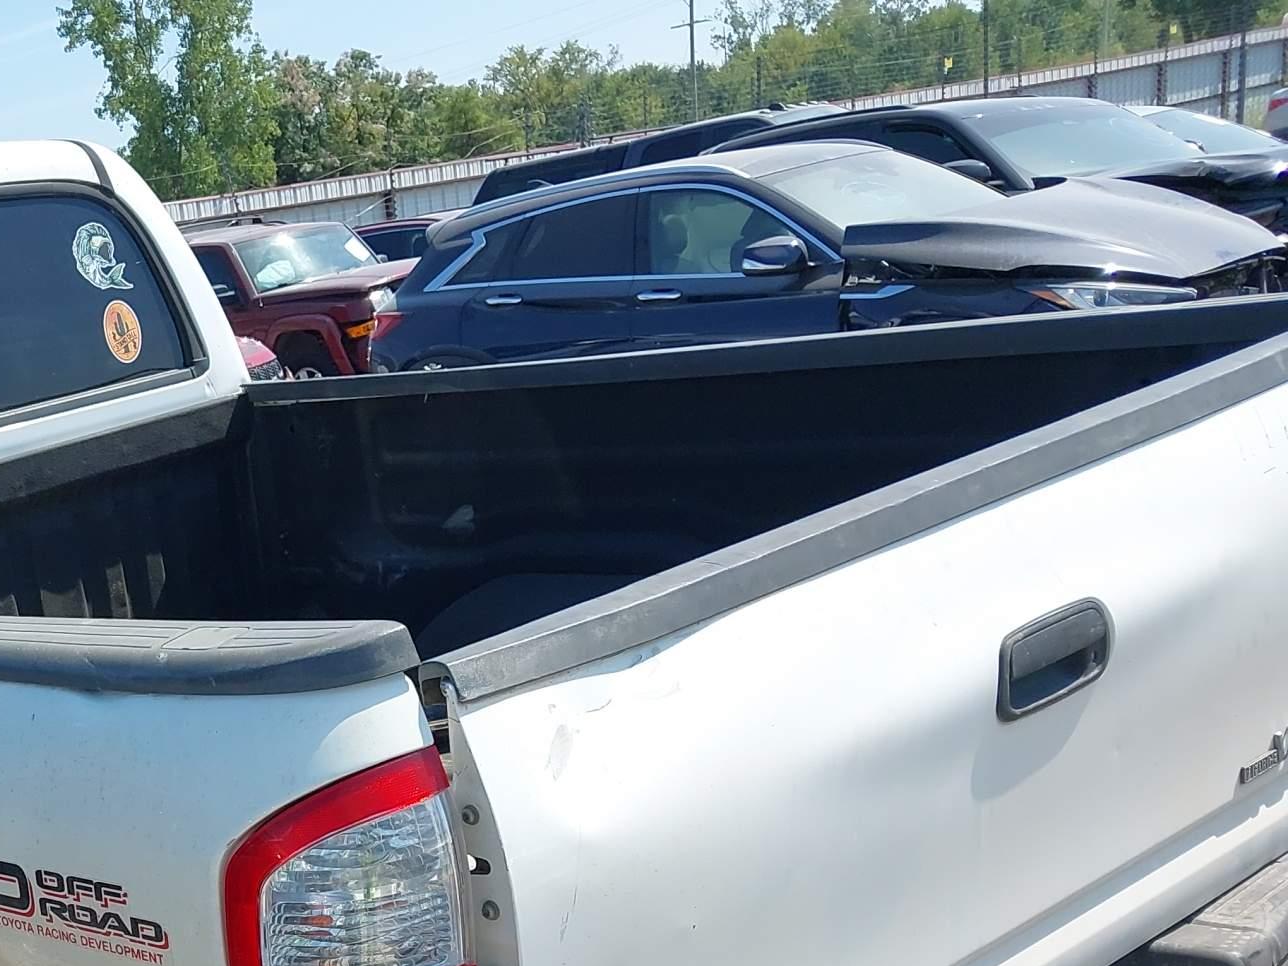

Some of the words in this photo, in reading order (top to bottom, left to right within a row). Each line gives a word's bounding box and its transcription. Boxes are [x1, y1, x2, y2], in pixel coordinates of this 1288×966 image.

[35, 869, 128, 908] OFF
[38, 897, 170, 950] ROAD
[37, 926, 77, 945] RACING
[79, 935, 165, 966] DEVELOPMENT
